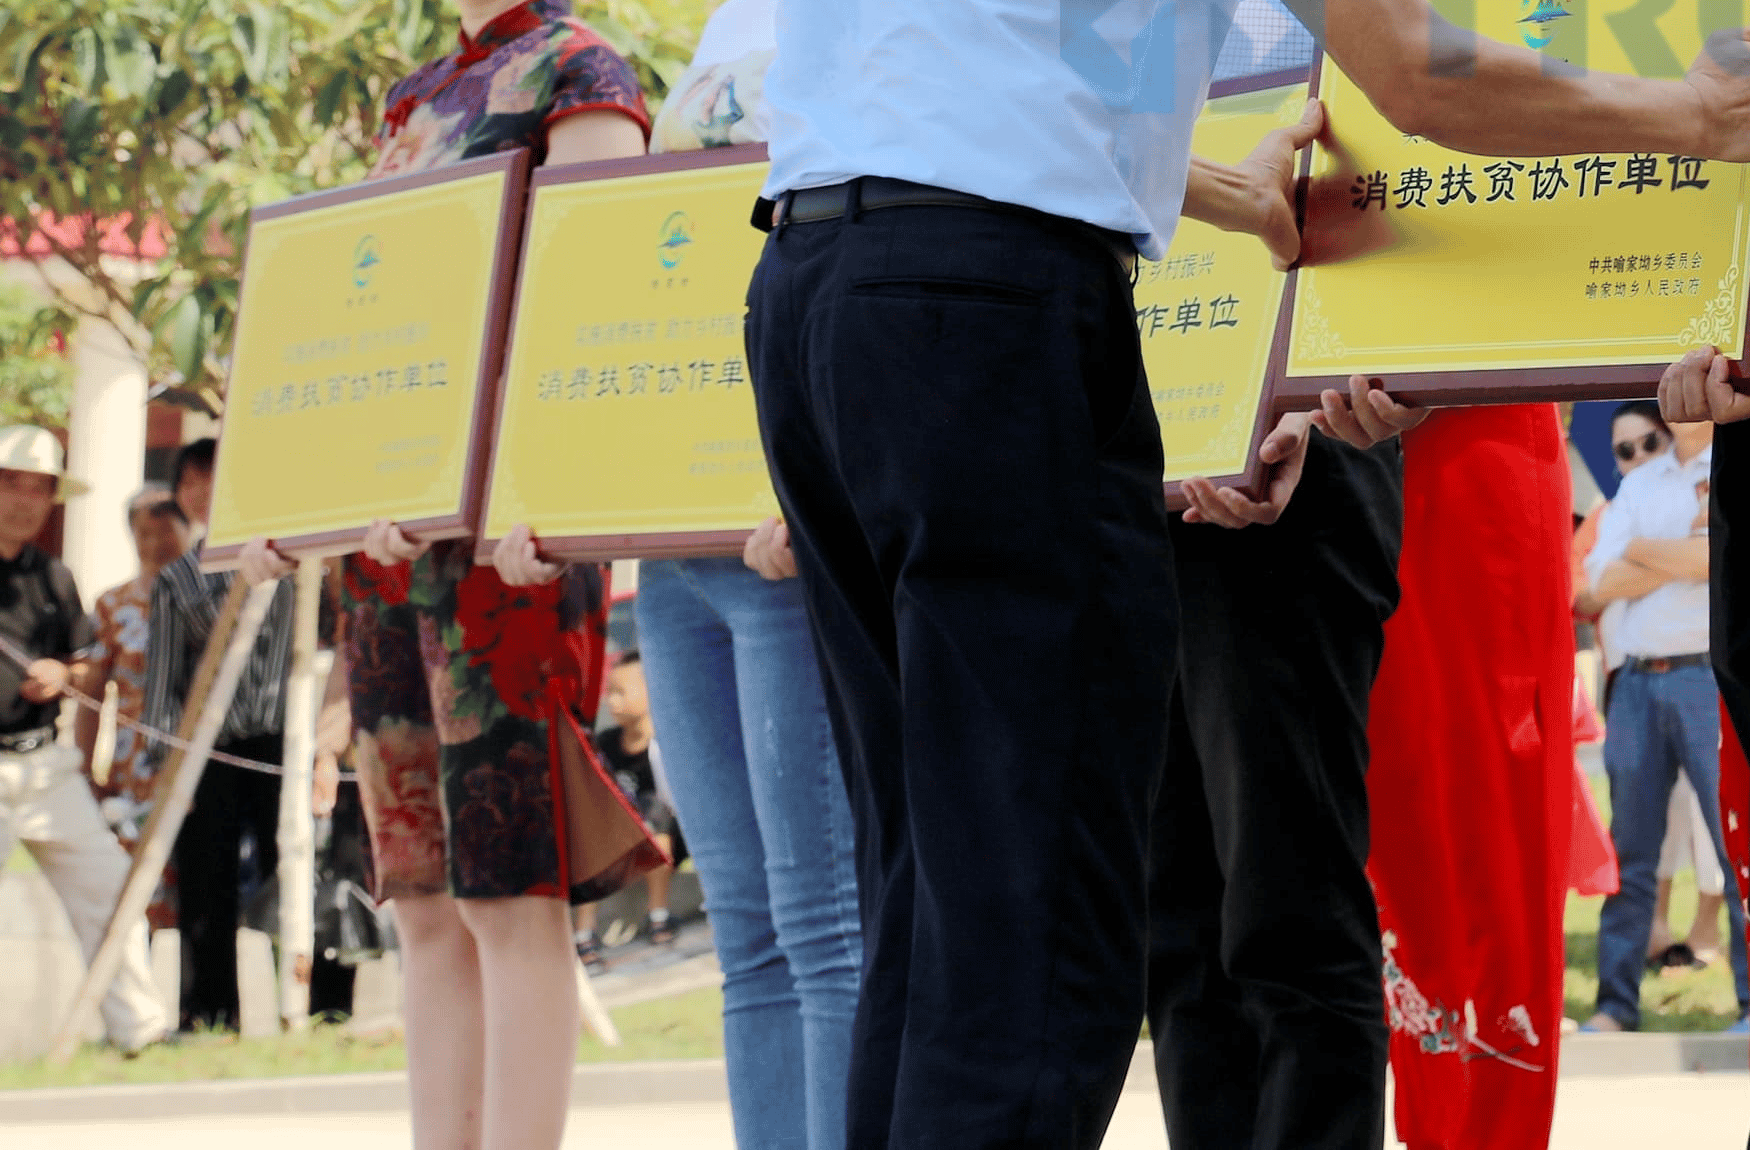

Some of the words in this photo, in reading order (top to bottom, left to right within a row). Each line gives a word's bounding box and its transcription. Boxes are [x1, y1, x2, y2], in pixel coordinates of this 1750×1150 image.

[1349, 152, 1711, 213] 消费扶贫协作单位
[1588, 251, 1703, 275] 中共喻家坳乡委员会
[1585, 277, 1701, 299] 喻家坳乡人民政府
